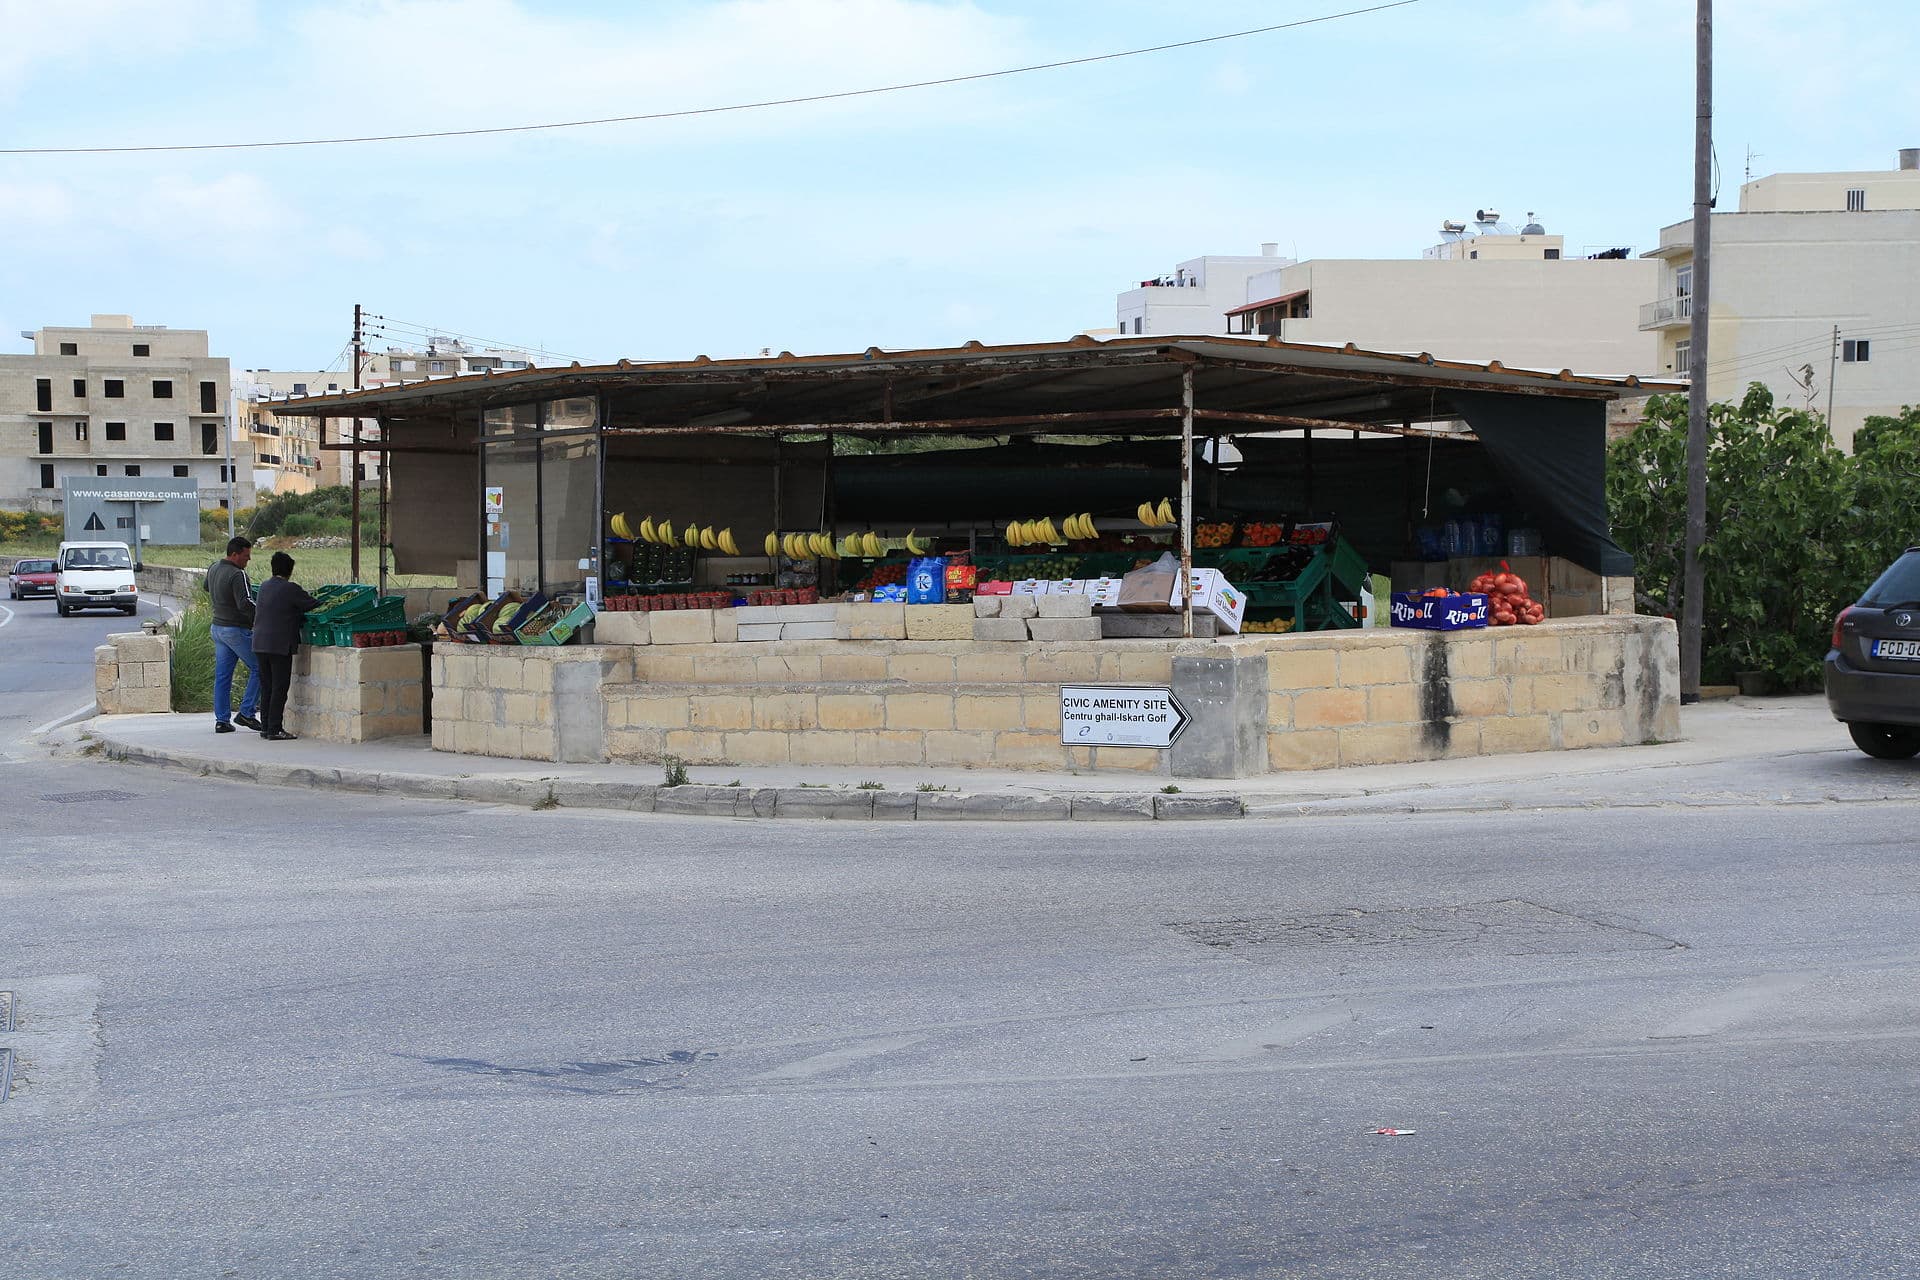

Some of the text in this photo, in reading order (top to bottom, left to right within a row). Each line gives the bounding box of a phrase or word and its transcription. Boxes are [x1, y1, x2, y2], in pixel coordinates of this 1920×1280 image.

[72, 489, 198, 499] www.casanova.com.mt
[1391, 602, 1434, 622] Ripoll
[1445, 606, 1487, 625] Ripoll
[1063, 698, 1167, 710] CIVIC AMENITY SITE
[1147, 713, 1167, 722] Goff
